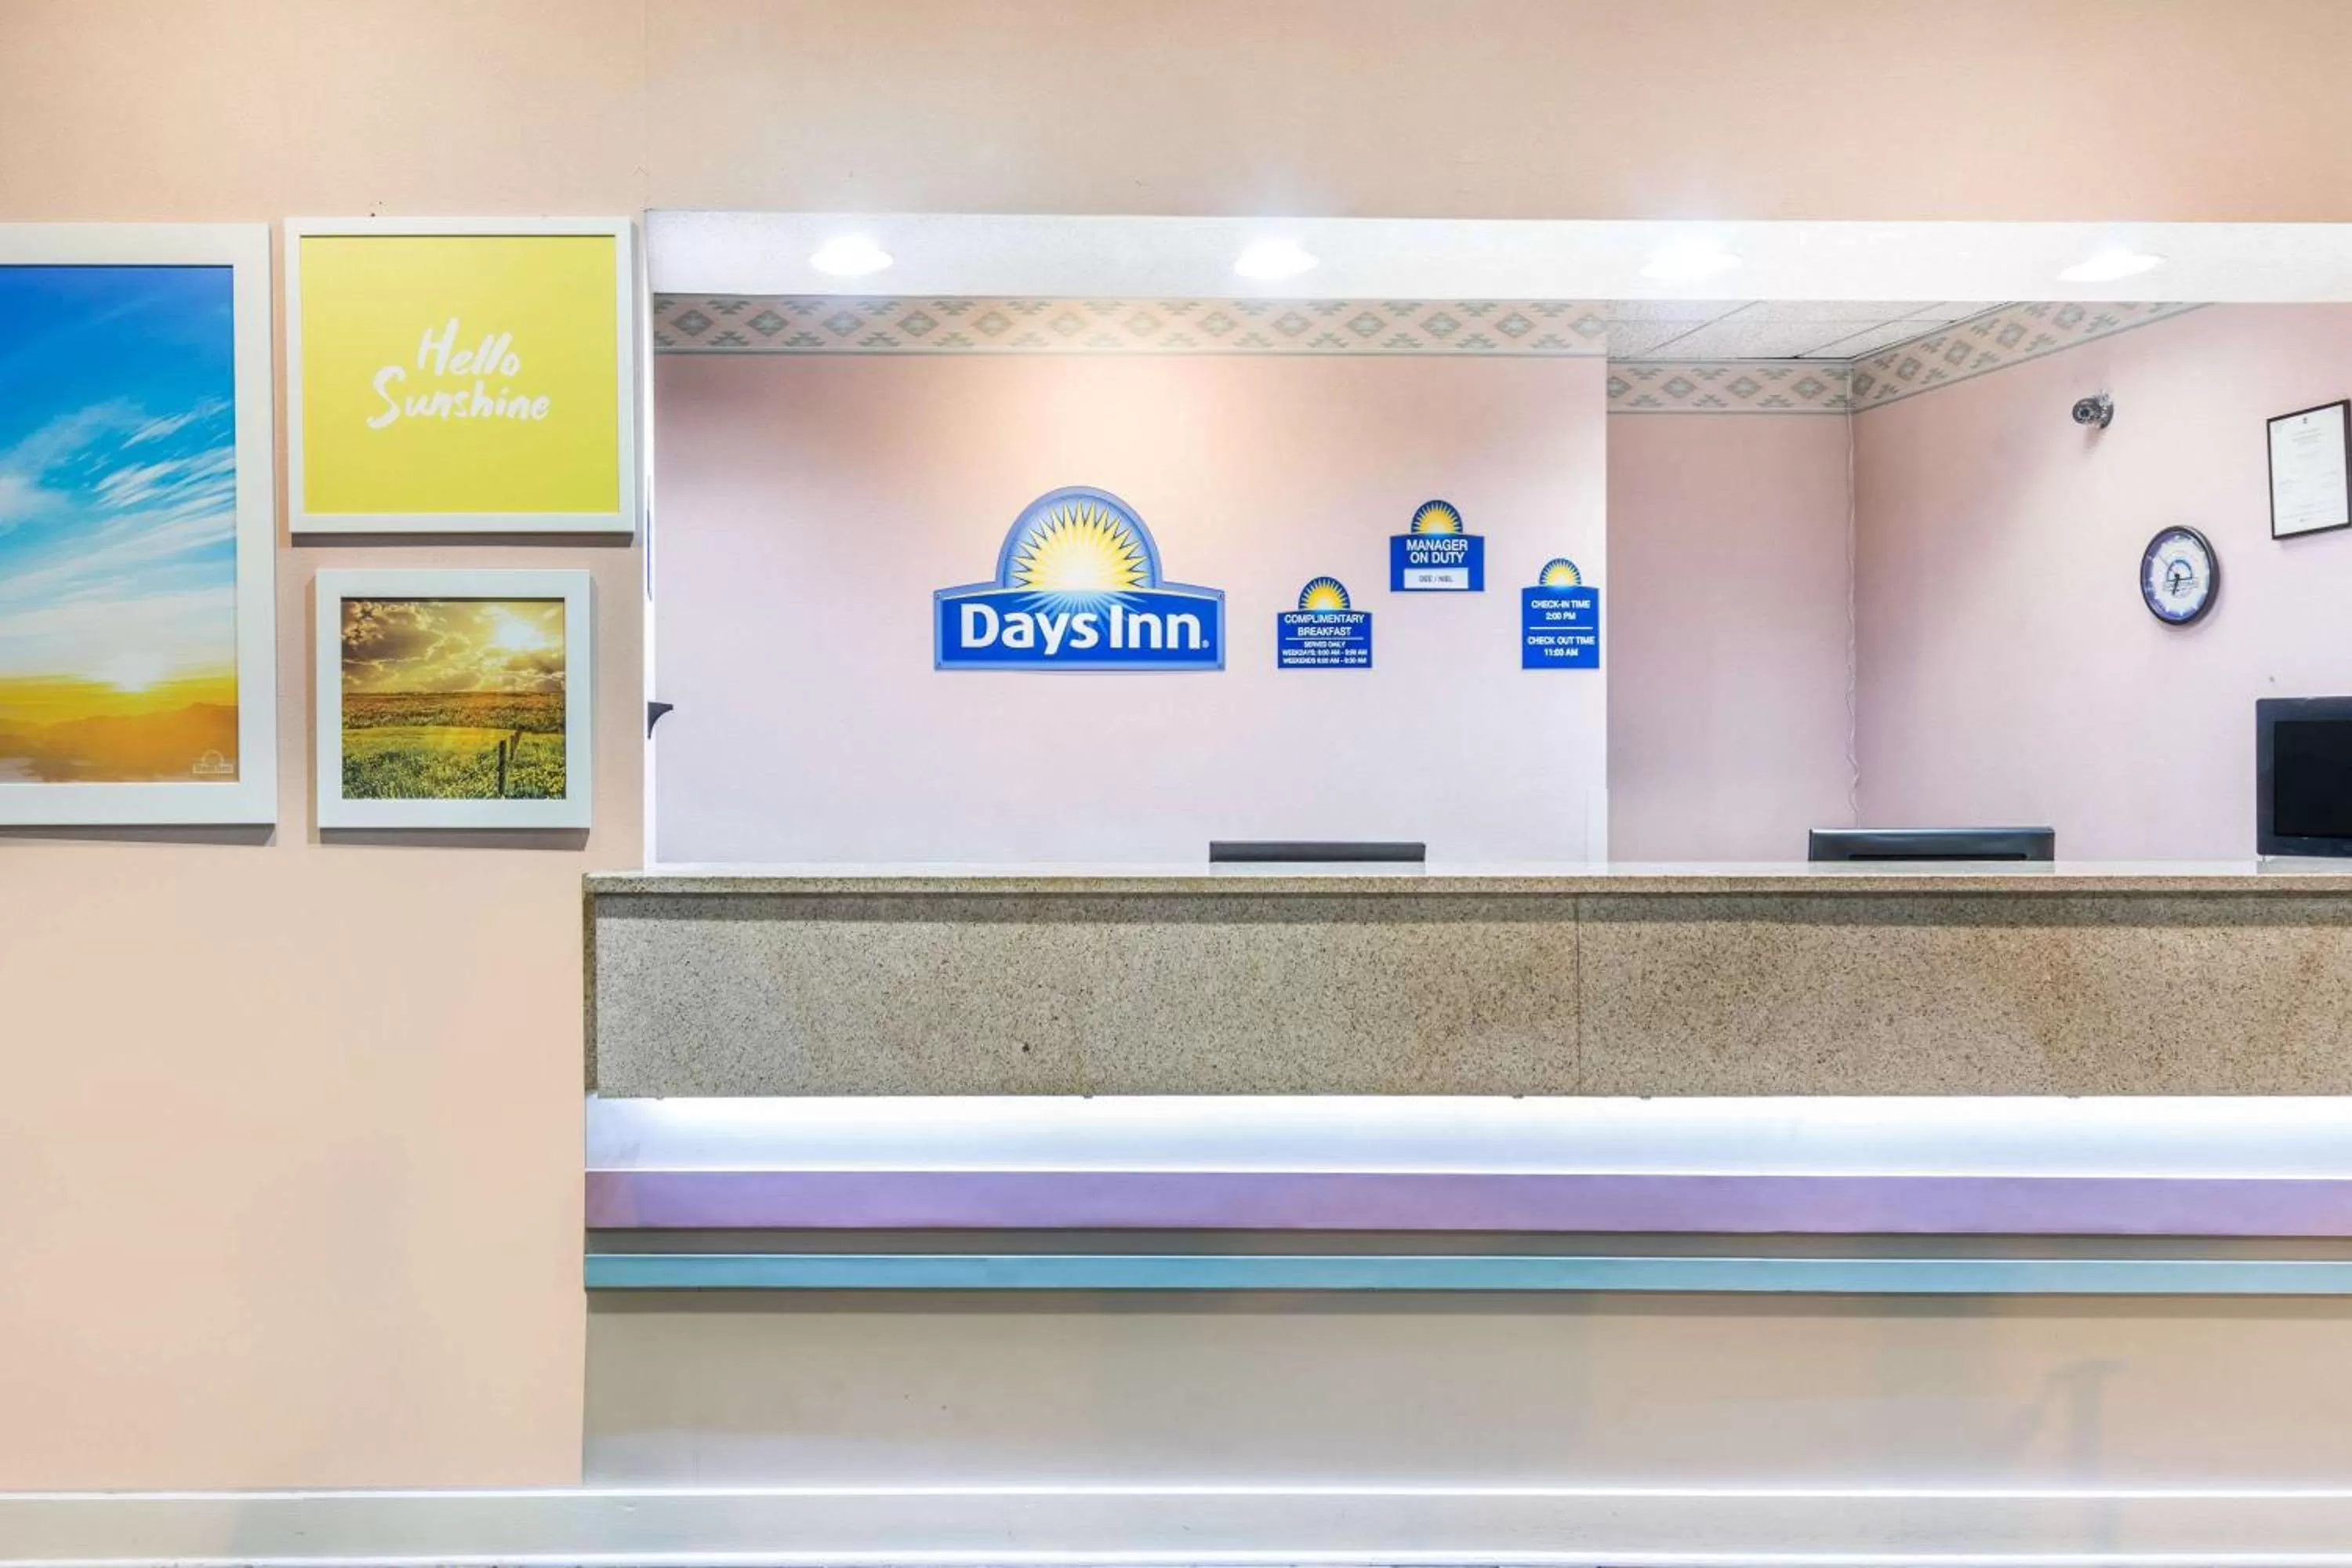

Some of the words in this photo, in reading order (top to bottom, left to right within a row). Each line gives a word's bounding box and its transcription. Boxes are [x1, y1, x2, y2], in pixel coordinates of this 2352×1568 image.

[417, 317, 521, 377] Hello
[366, 365, 550, 429] Sunshine
[1406, 539, 1468, 551] MANAGER
[1410, 551, 1428, 564] ON
[1431, 551, 1465, 564] DUTY
[1531, 600, 1570, 608] CHECK-IN
[1570, 600, 1591, 608] TIME
[1284, 614, 1364, 623] COMPLIMENTARY
[1545, 612, 1562, 620] 2:00
[1563, 612, 1577, 620] PM
[960, 603, 1098, 655] Days
[1109, 604, 1201, 649] Inn
[1298, 626, 1352, 636] BREAKFAST
[1527, 636, 1555, 644] CHECK
[1556, 636, 1574, 644] OUT
[1576, 636, 1595, 644] TIME
